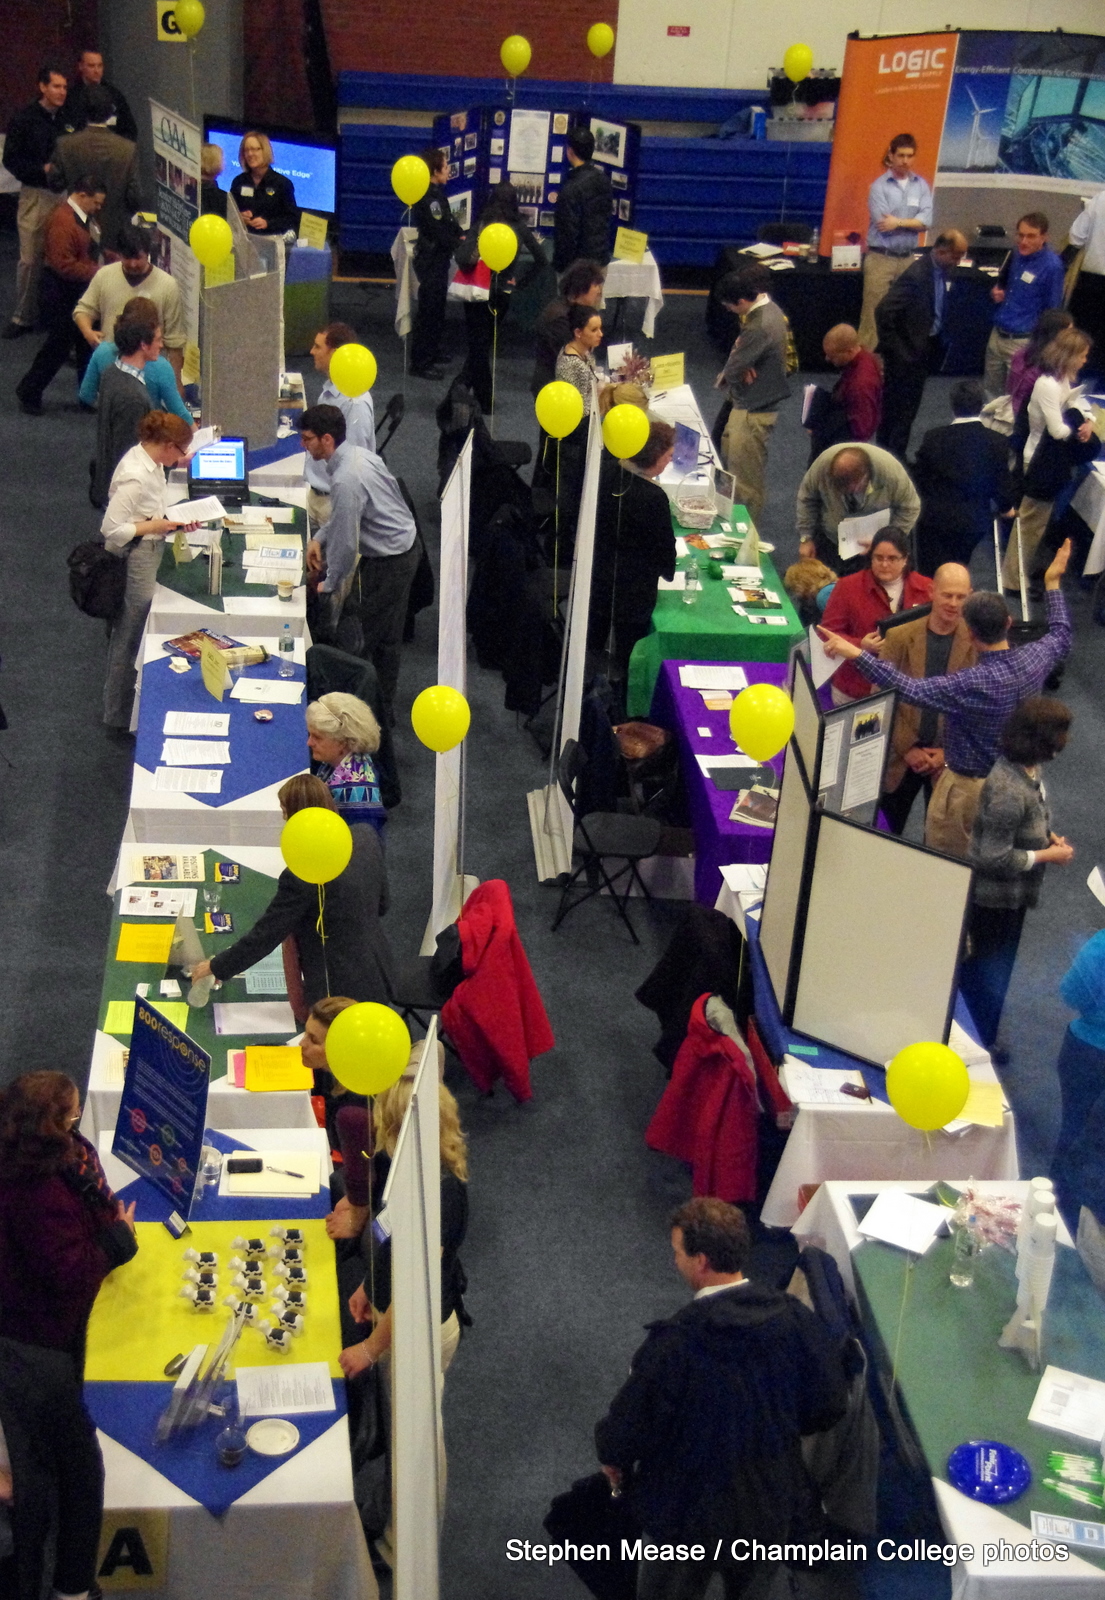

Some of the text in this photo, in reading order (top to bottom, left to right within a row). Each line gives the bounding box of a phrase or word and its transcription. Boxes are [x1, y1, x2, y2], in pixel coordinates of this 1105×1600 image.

[161, 10, 182, 35] G
[878, 48, 947, 75] LOGIC
[954, 65, 1011, 76] Energy-Efficient
[1012, 66, 1054, 76] Computers
[138, 1006, 206, 1072] 800response
[98, 1526, 154, 1577] A
